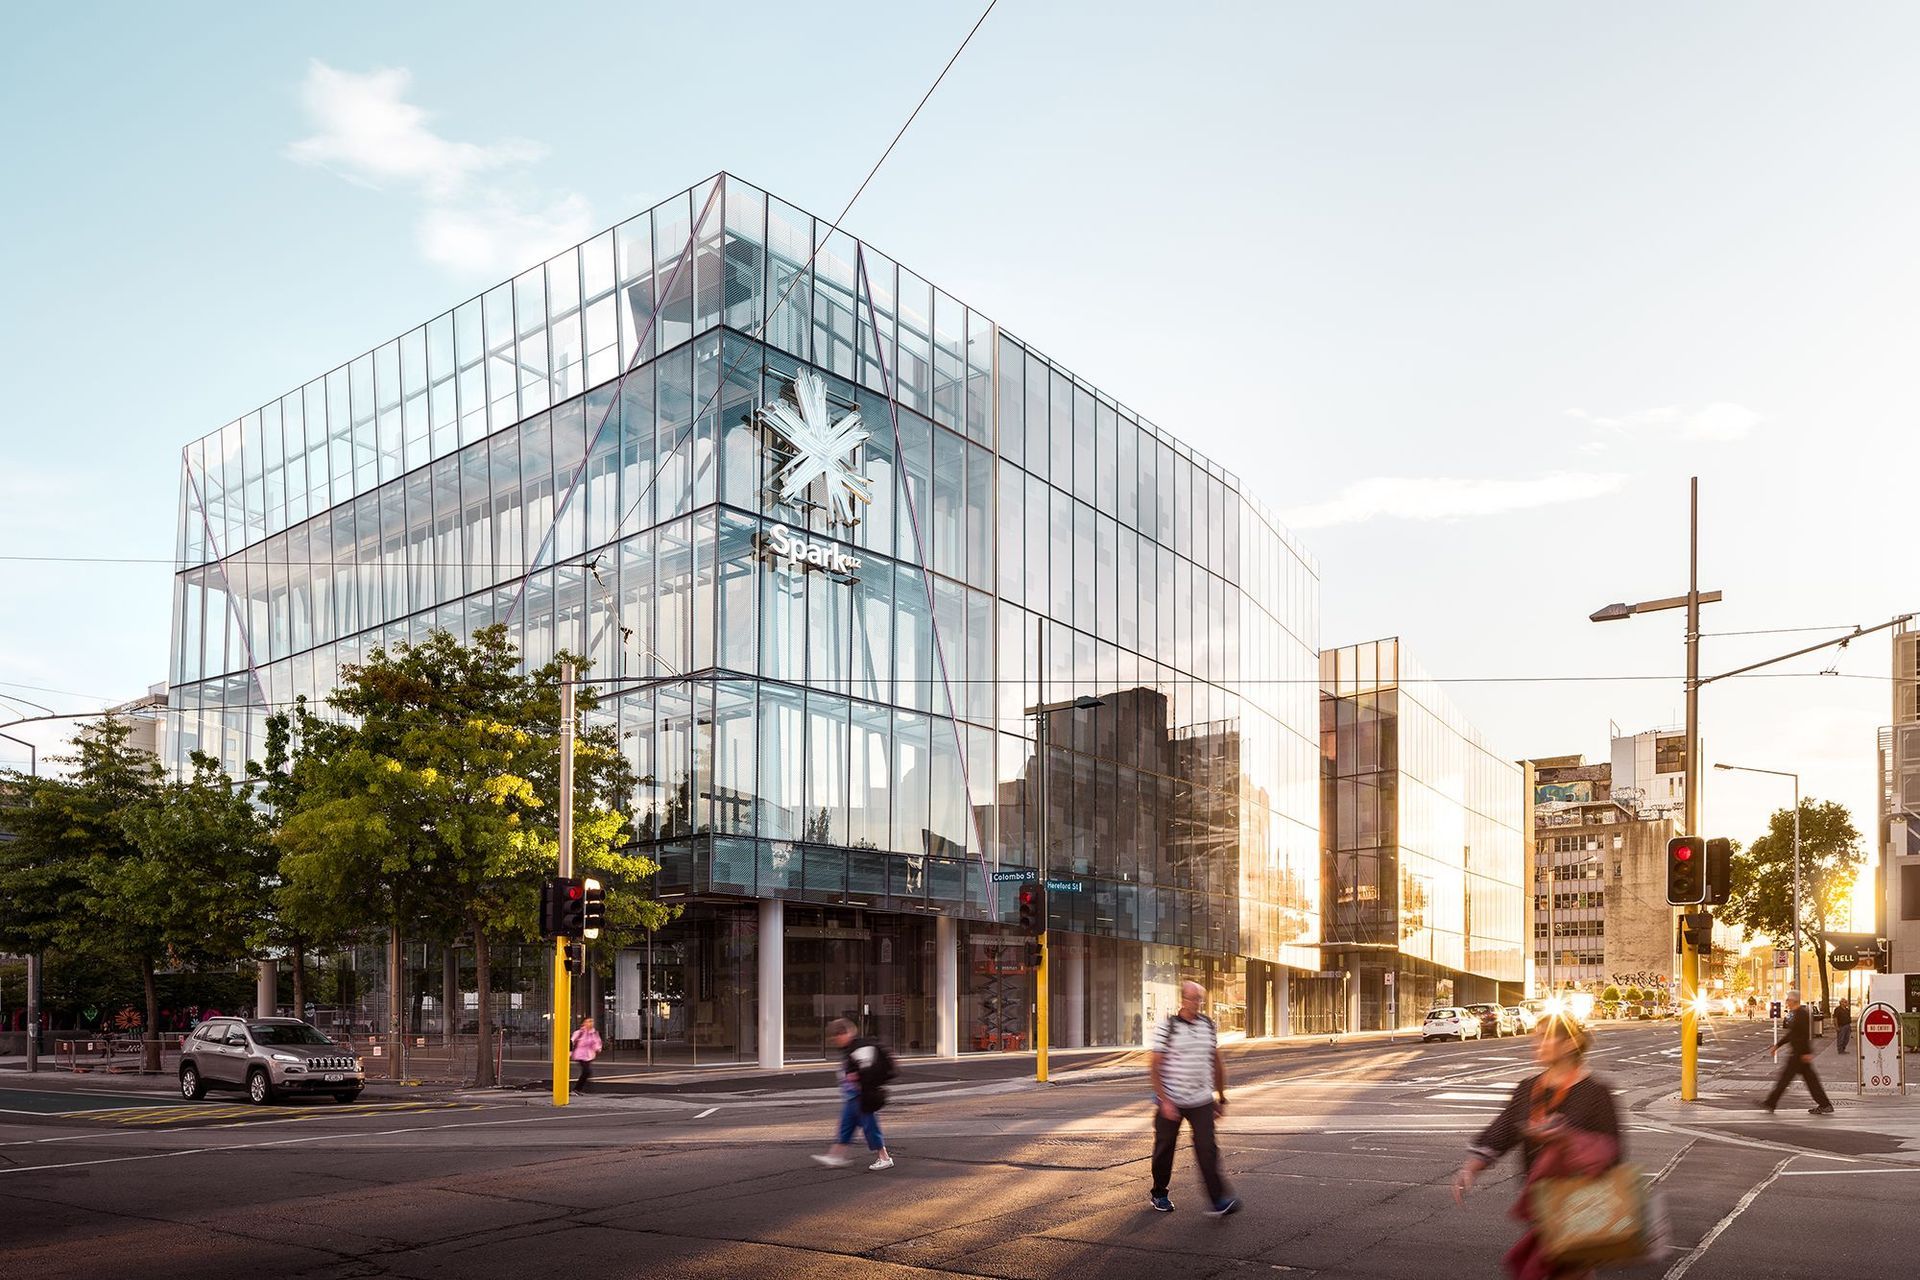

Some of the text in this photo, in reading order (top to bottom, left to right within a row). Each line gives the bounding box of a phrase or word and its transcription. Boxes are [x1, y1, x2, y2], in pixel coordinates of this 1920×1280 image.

[769, 523, 848, 574] Spark
[993, 871, 1035, 881] Colombo St
[1047, 882, 1079, 890] Hereford St
